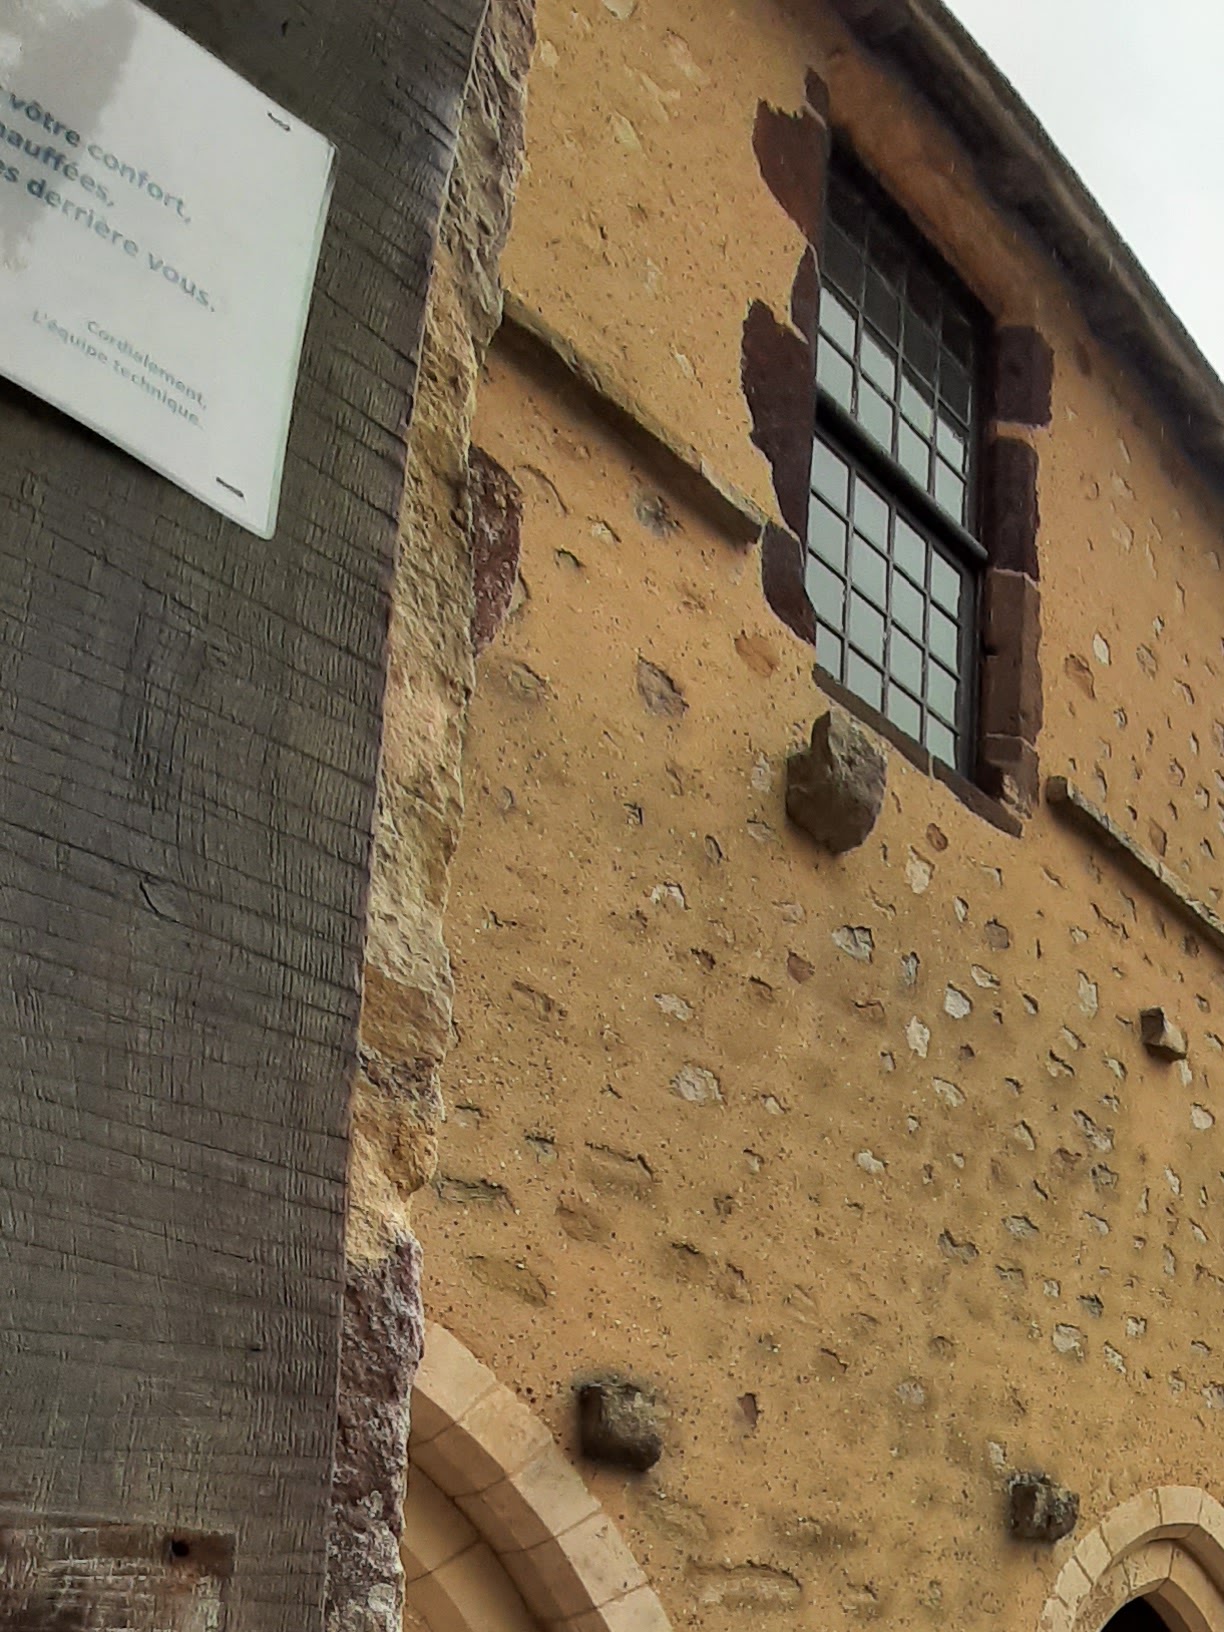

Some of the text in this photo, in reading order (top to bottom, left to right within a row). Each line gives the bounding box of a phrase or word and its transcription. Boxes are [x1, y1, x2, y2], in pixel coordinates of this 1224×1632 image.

[9, 92, 192, 224] vôtre confort,
[26, 177, 139, 257] derrière
